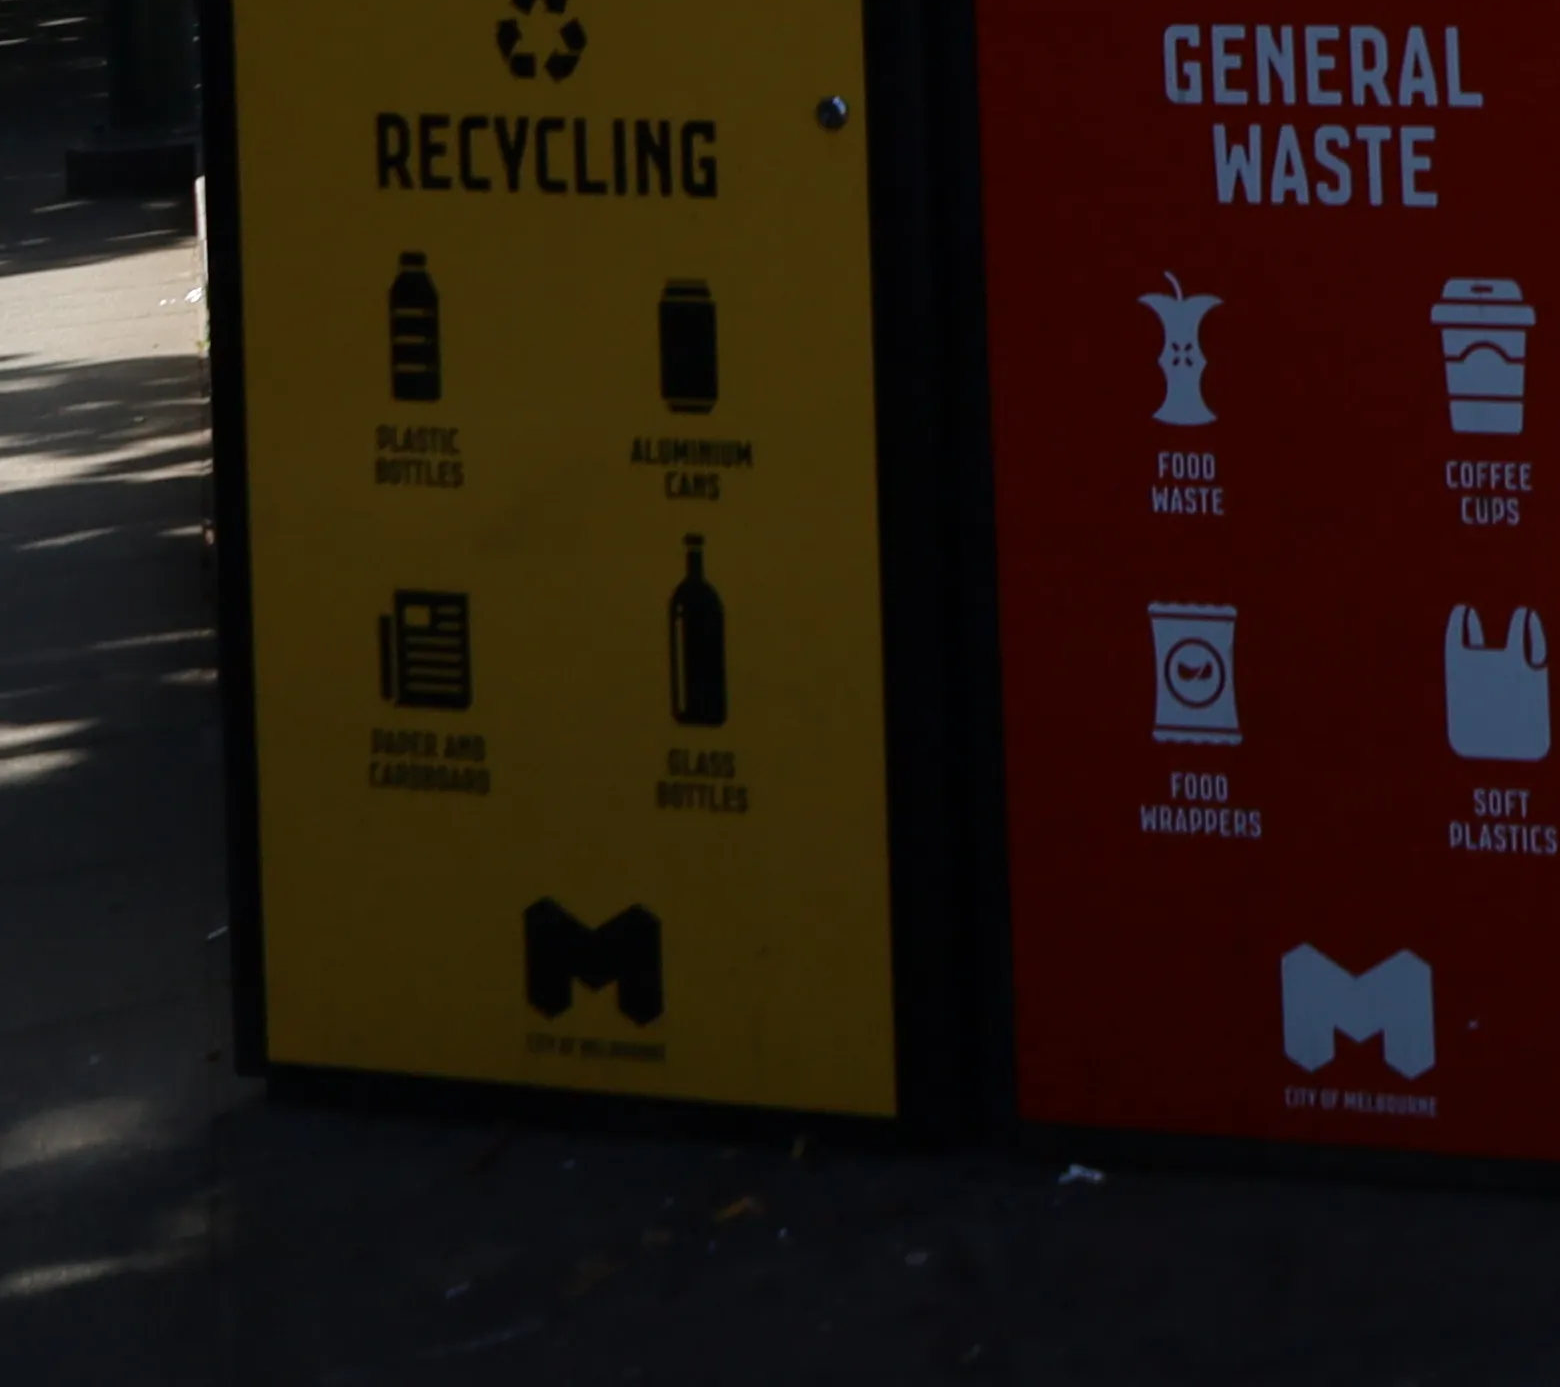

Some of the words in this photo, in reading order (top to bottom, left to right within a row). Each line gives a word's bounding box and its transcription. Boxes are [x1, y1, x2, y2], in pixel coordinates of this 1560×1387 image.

[1163, 24, 1484, 107] GENERAL
[376, 112, 718, 199] RECYCLING
[1213, 123, 1438, 207] WASTE
[375, 424, 460, 455] PLASTIC
[630, 438, 754, 468] ALUMINIUM
[374, 456, 464, 489] BOTTLES
[1158, 451, 1216, 480] FOOD
[1445, 460, 1532, 490] COFFEE
[665, 471, 721, 501] CANS
[1151, 485, 1224, 515] WASTE
[1461, 495, 1520, 526] CUPS
[667, 748, 736, 779] GLASS
[655, 780, 749, 814] BOTTLES
[1170, 772, 1228, 801] FOOD
[1473, 788, 1529, 817] SOFT
[1140, 805, 1262, 838] WRAPPERS
[1449, 821, 1558, 855] PLASTICS
